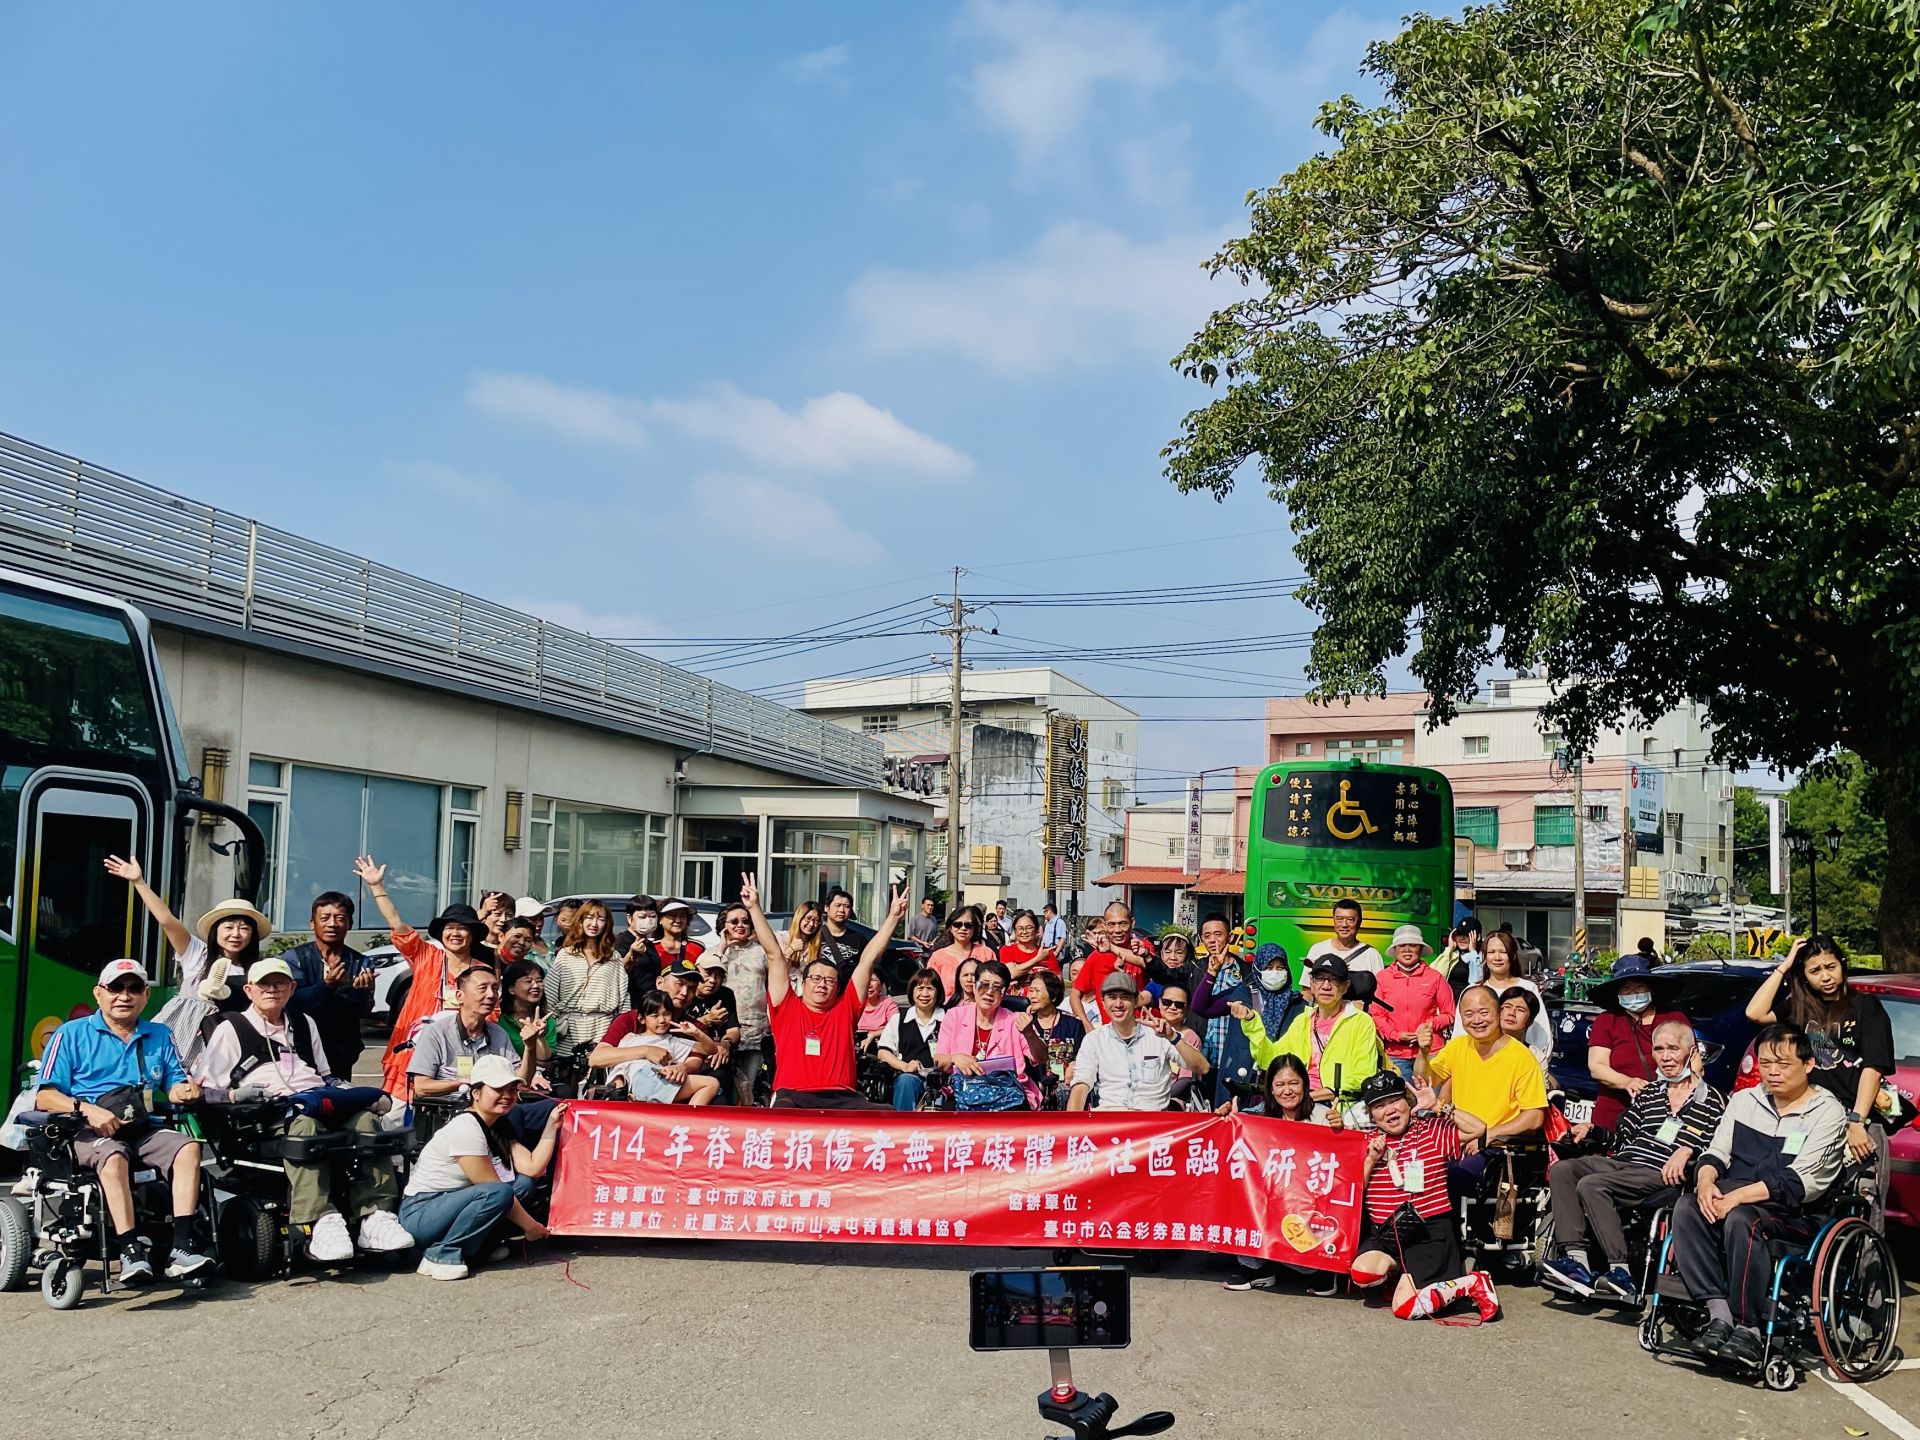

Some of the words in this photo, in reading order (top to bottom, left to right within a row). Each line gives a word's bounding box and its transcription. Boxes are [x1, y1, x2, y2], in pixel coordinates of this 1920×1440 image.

[1068, 725, 1088, 863] 小橋流水
[1307, 884, 1393, 900] VOLVO
